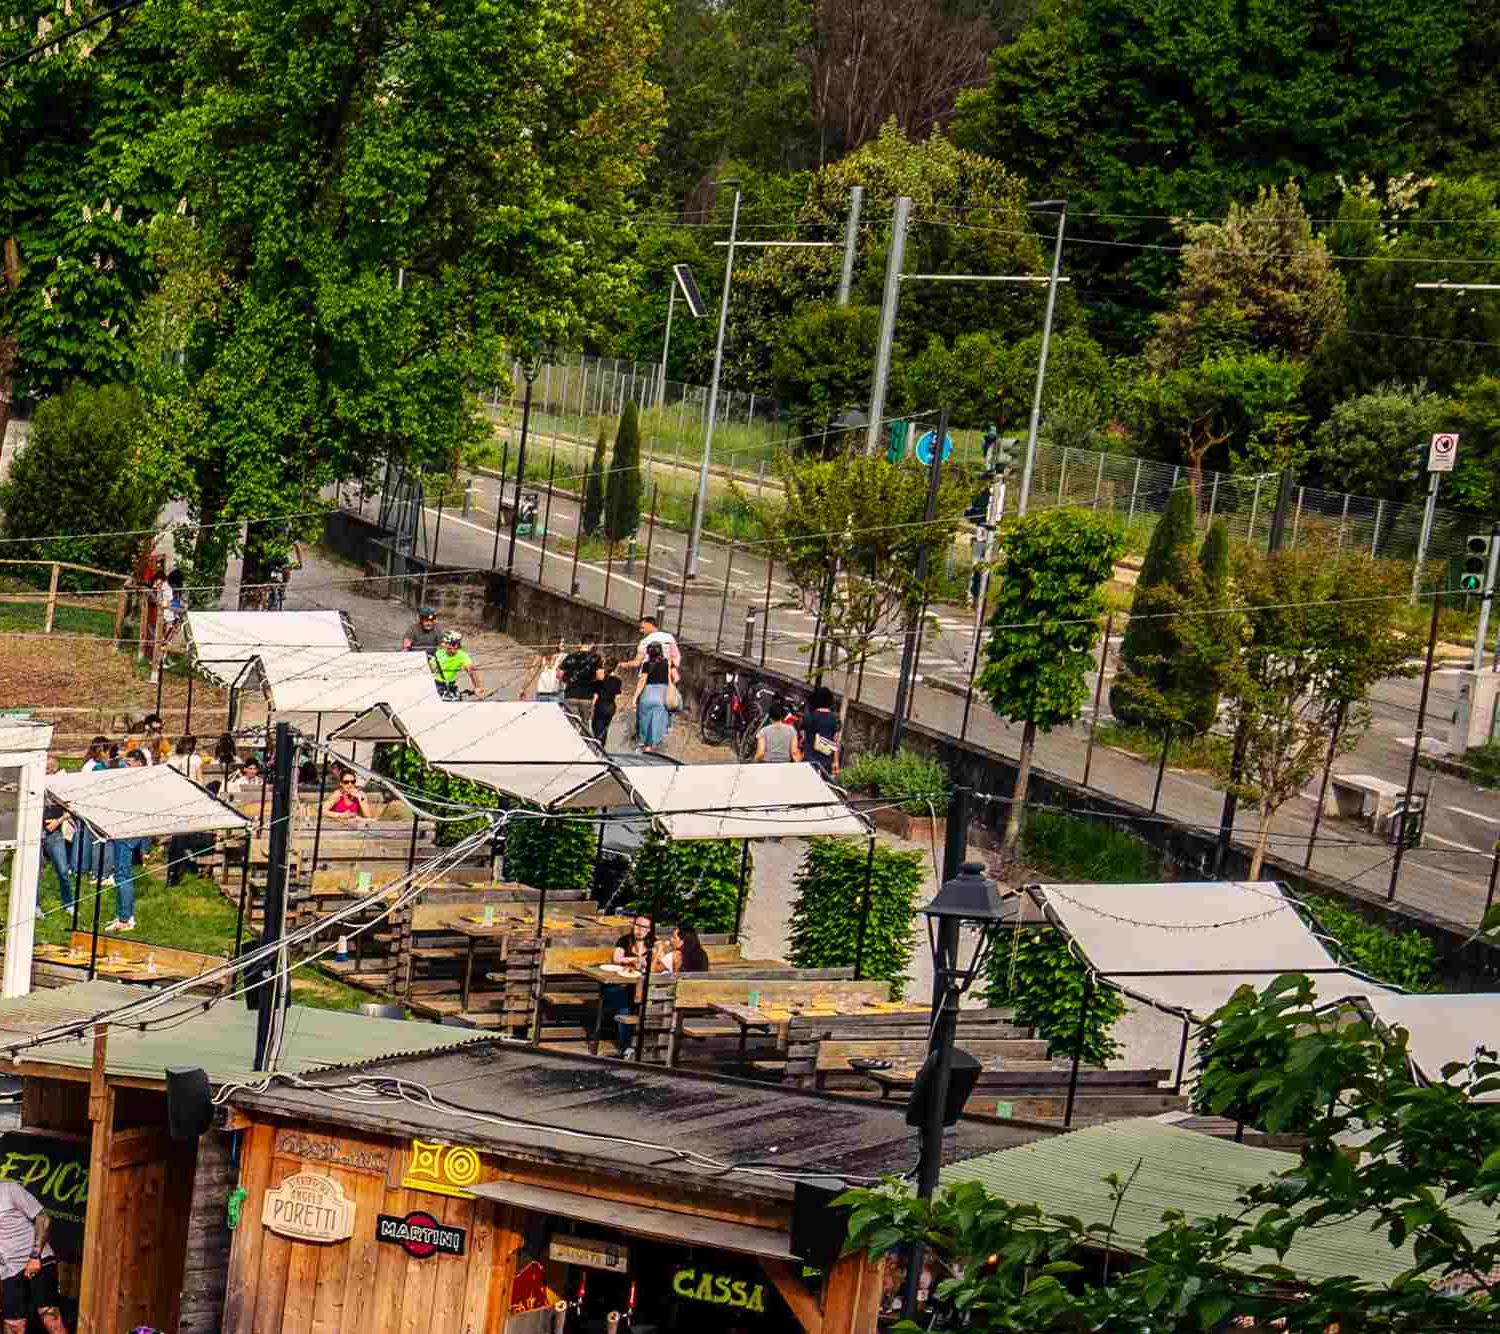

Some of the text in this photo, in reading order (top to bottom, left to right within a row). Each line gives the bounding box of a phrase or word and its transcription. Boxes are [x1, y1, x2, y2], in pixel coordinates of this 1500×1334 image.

[273, 1197, 337, 1231] PORETTI
[381, 1220, 461, 1252] MARTINI
[673, 1268, 765, 1313] CASSA
